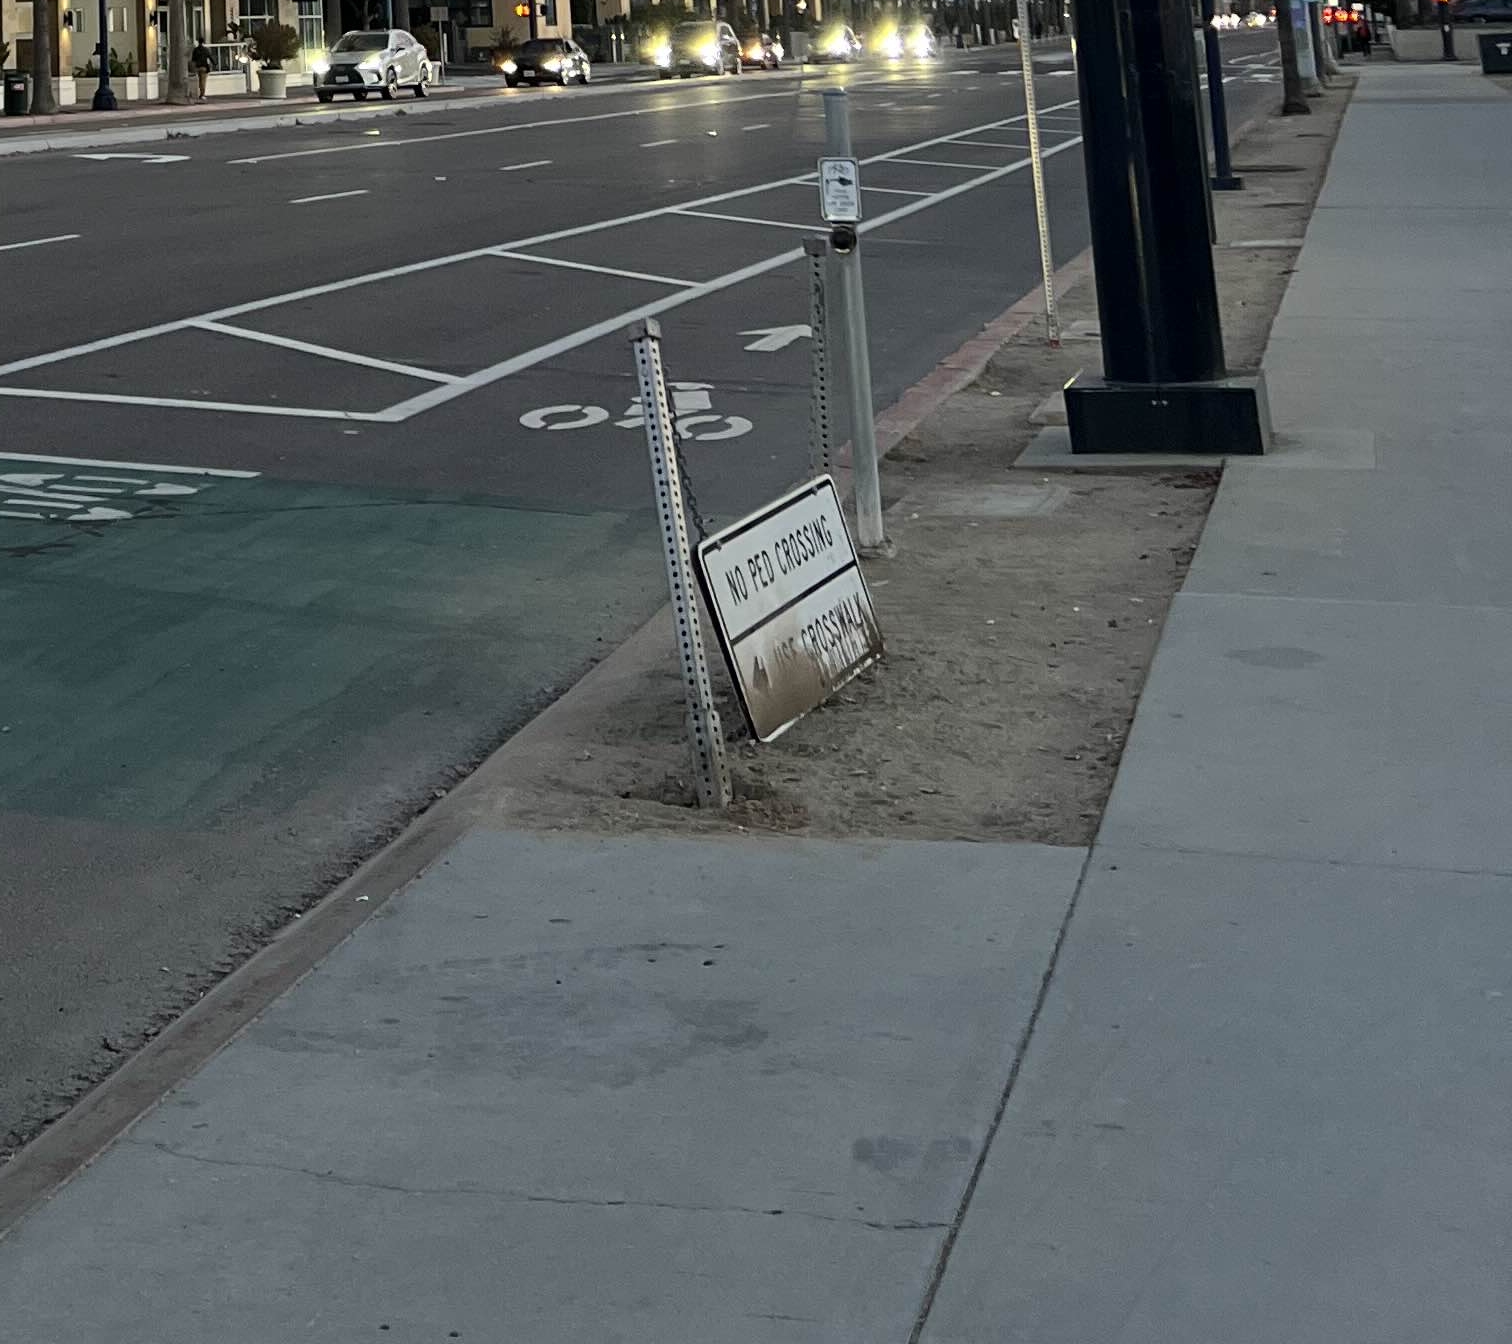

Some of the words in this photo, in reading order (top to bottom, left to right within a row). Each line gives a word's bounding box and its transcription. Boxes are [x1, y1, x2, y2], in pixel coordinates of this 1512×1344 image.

[724, 564, 749, 607] NO
[746, 549, 775, 593] PED
[774, 514, 834, 578] CROSSING
[800, 590, 865, 657] CROSSWALK
